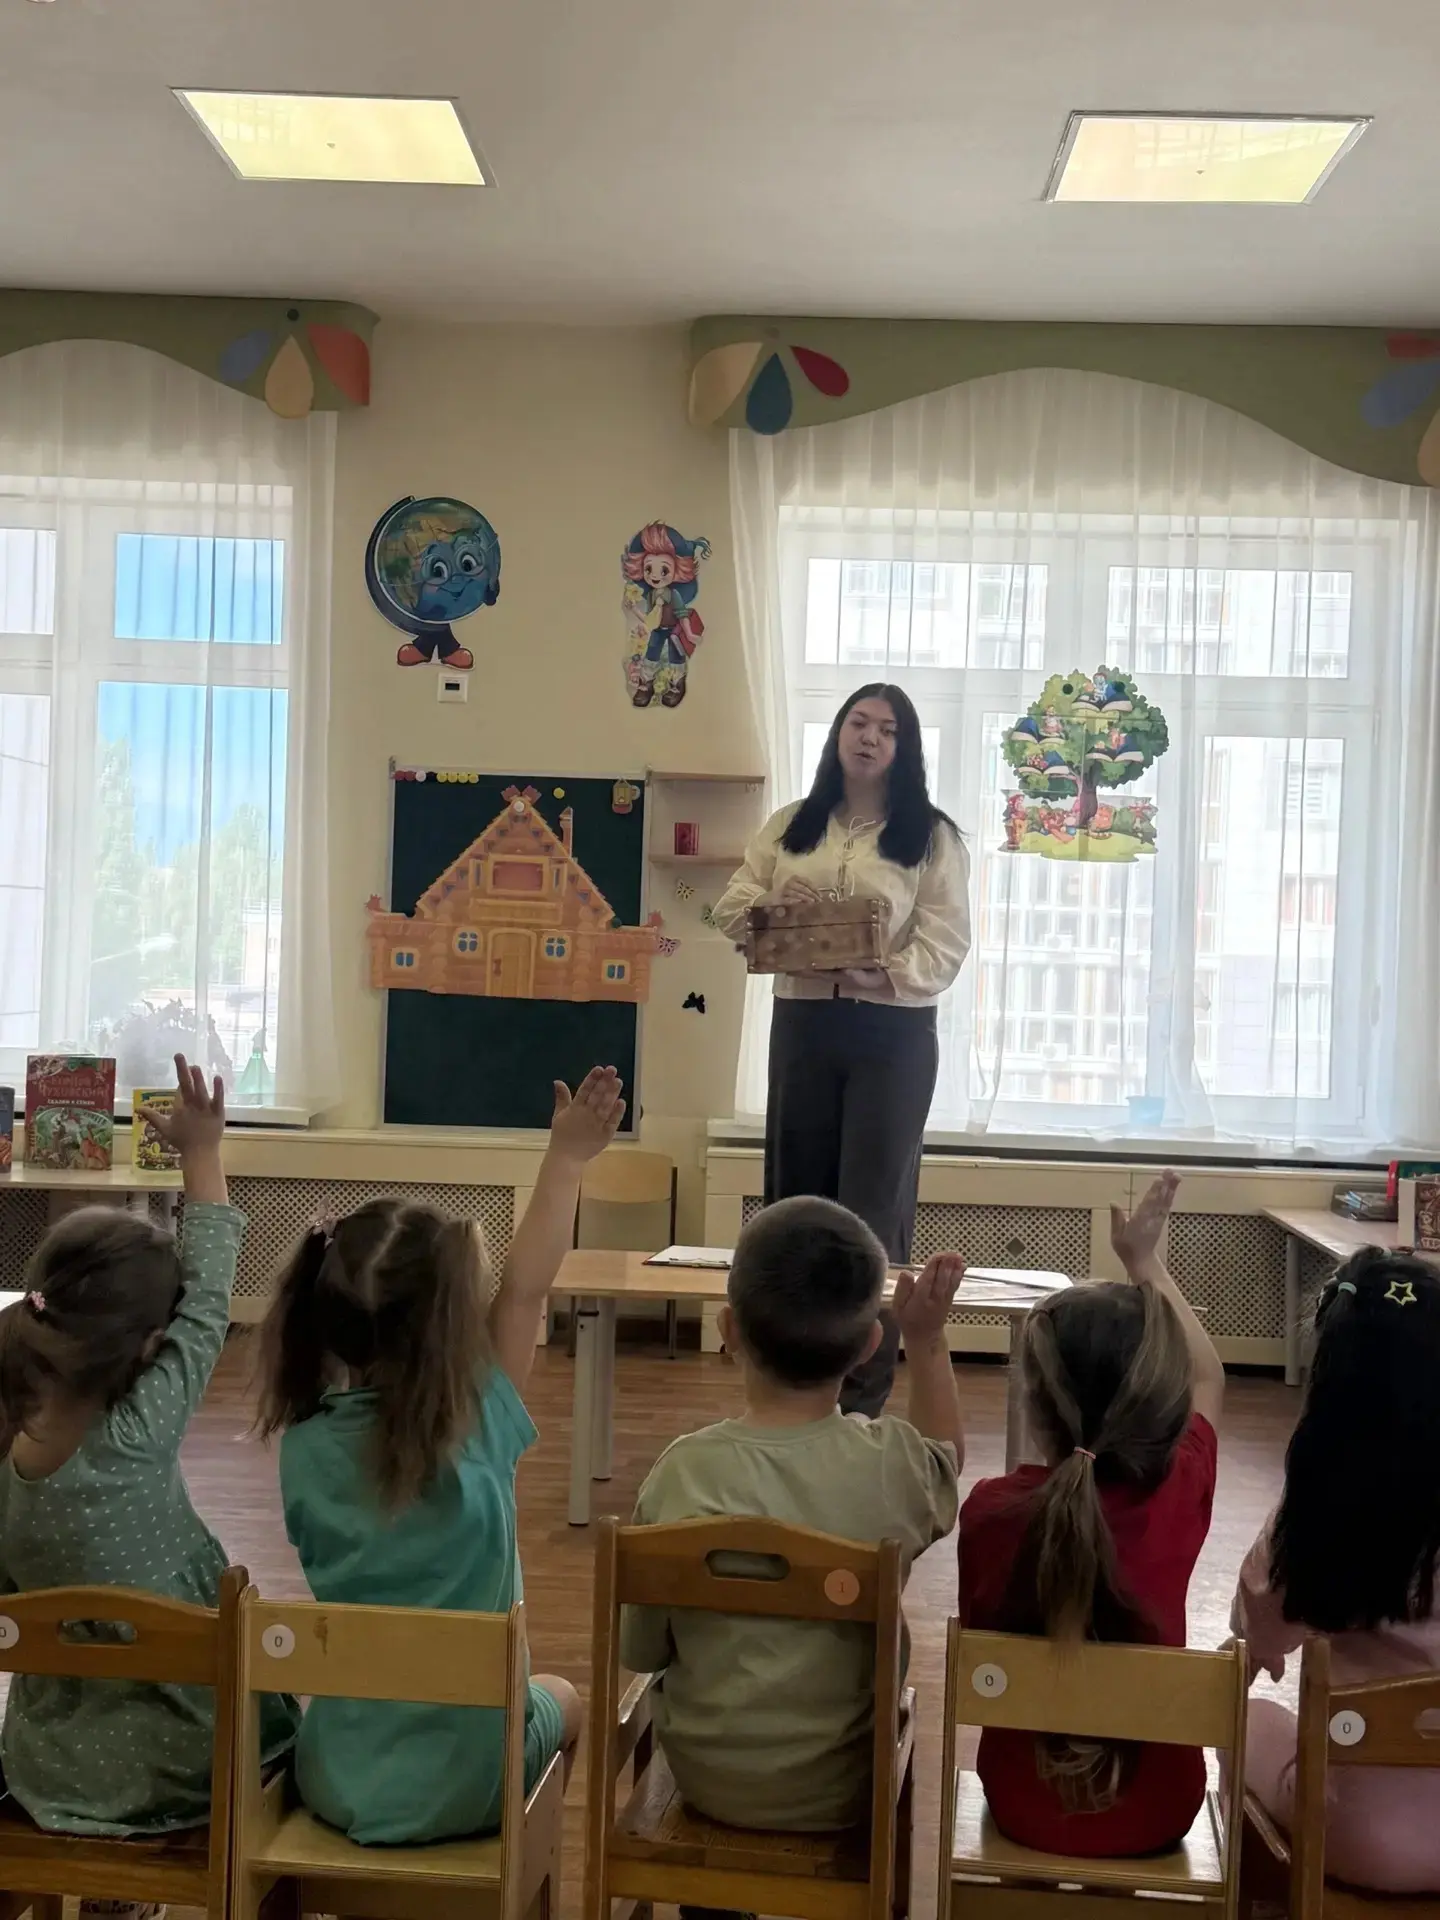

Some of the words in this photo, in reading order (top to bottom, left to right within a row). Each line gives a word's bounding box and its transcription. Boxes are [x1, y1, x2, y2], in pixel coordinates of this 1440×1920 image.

[274, 1636, 283, 1647] 0
[985, 1674, 994, 1687] 0
[1342, 1722, 1351, 1734] 0
